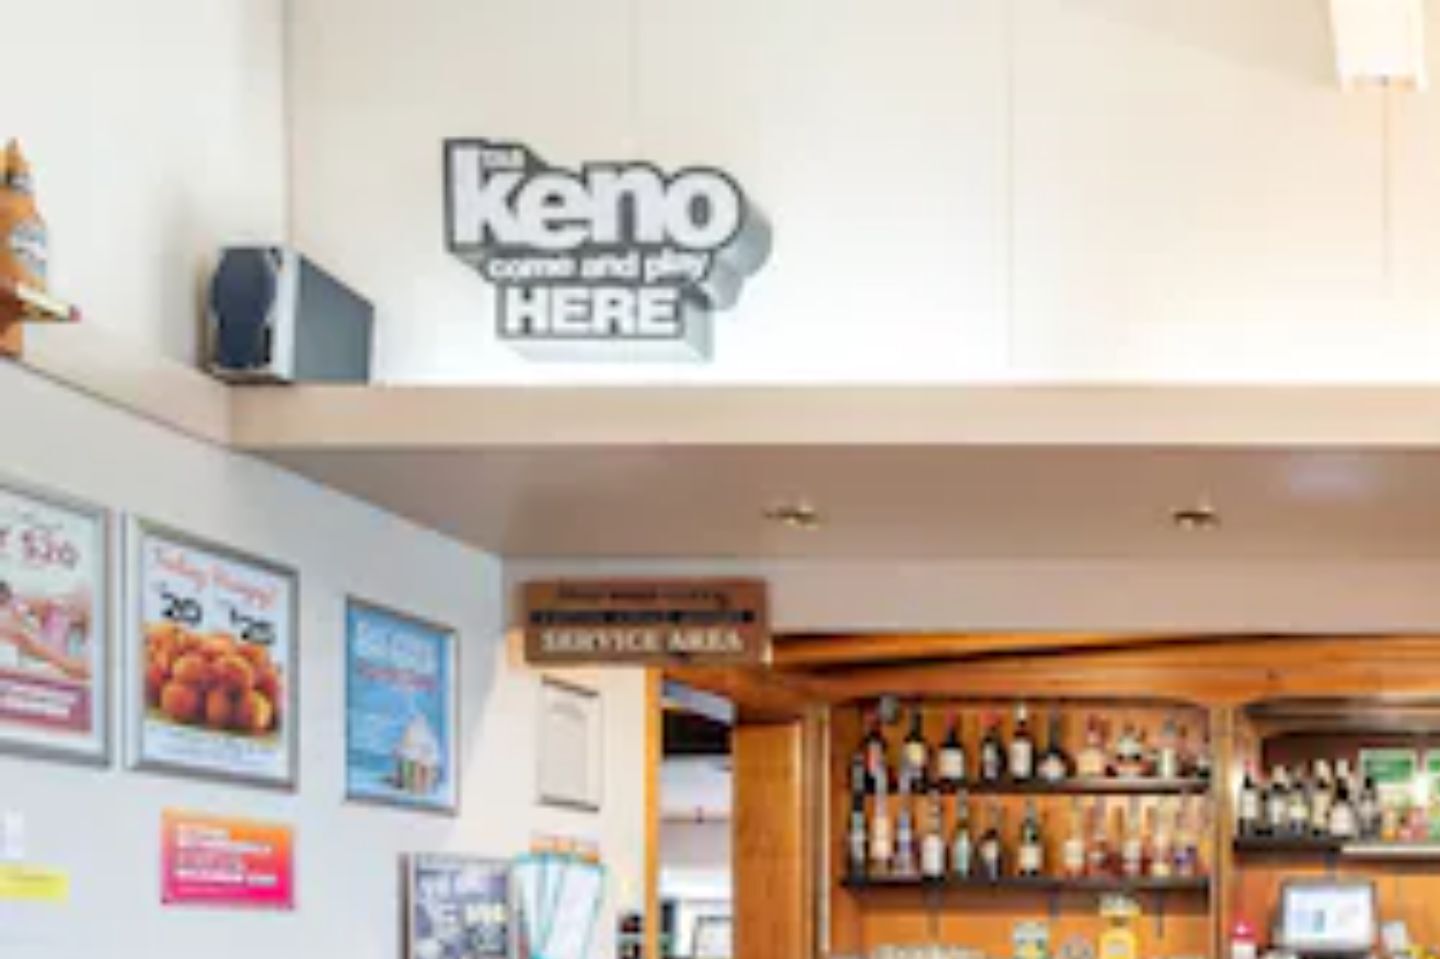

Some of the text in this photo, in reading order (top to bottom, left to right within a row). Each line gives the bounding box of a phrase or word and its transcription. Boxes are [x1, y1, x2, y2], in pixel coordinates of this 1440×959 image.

[450, 143, 740, 250] keno
[488, 247, 708, 284] come and play
[503, 284, 682, 338] HERE
